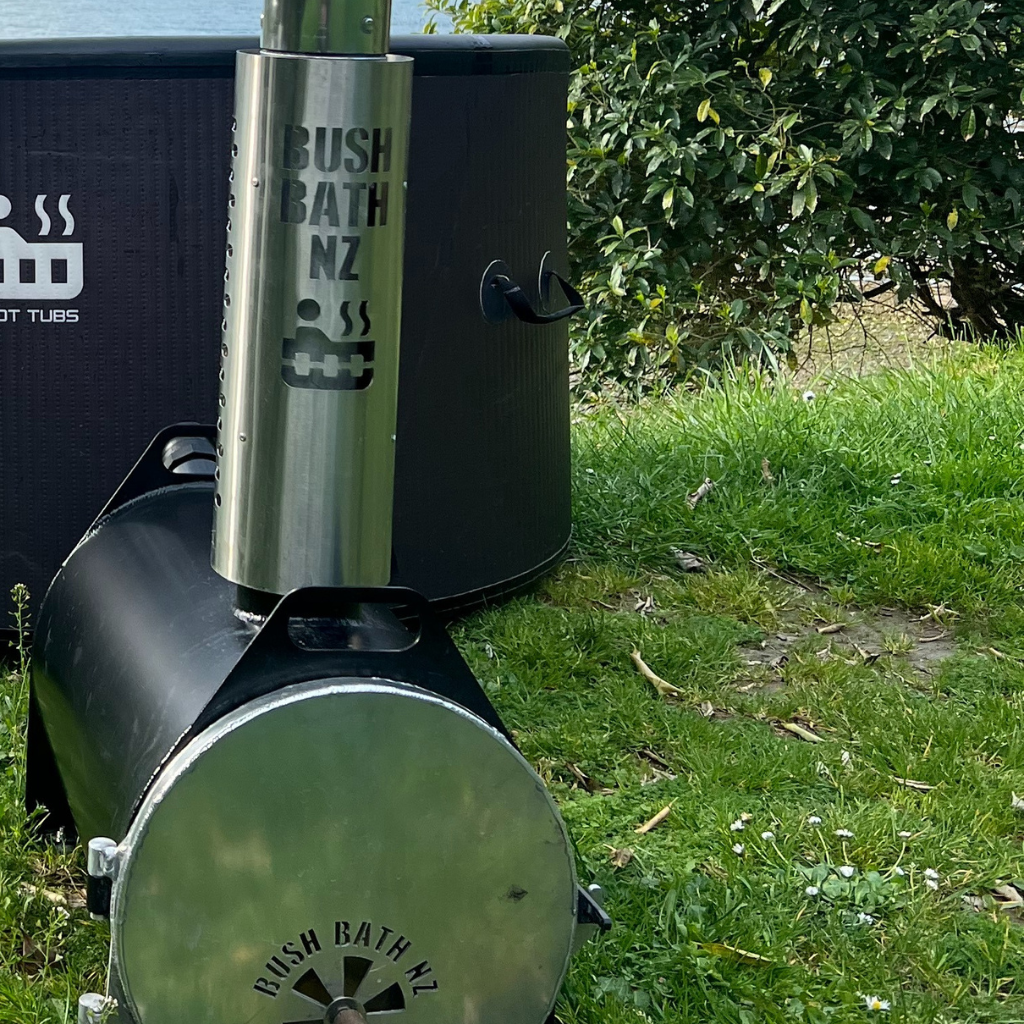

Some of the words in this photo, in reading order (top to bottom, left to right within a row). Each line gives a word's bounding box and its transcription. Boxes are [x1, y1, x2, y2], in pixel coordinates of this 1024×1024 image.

[283, 124, 392, 173] BUSH
[280, 178, 389, 227] BATH
[309, 234, 360, 281] NZ
[27, 309, 79, 323] TUBS
[253, 928, 322, 998] BUSH
[334, 921, 412, 963] BATH
[404, 960, 438, 998] NZ
